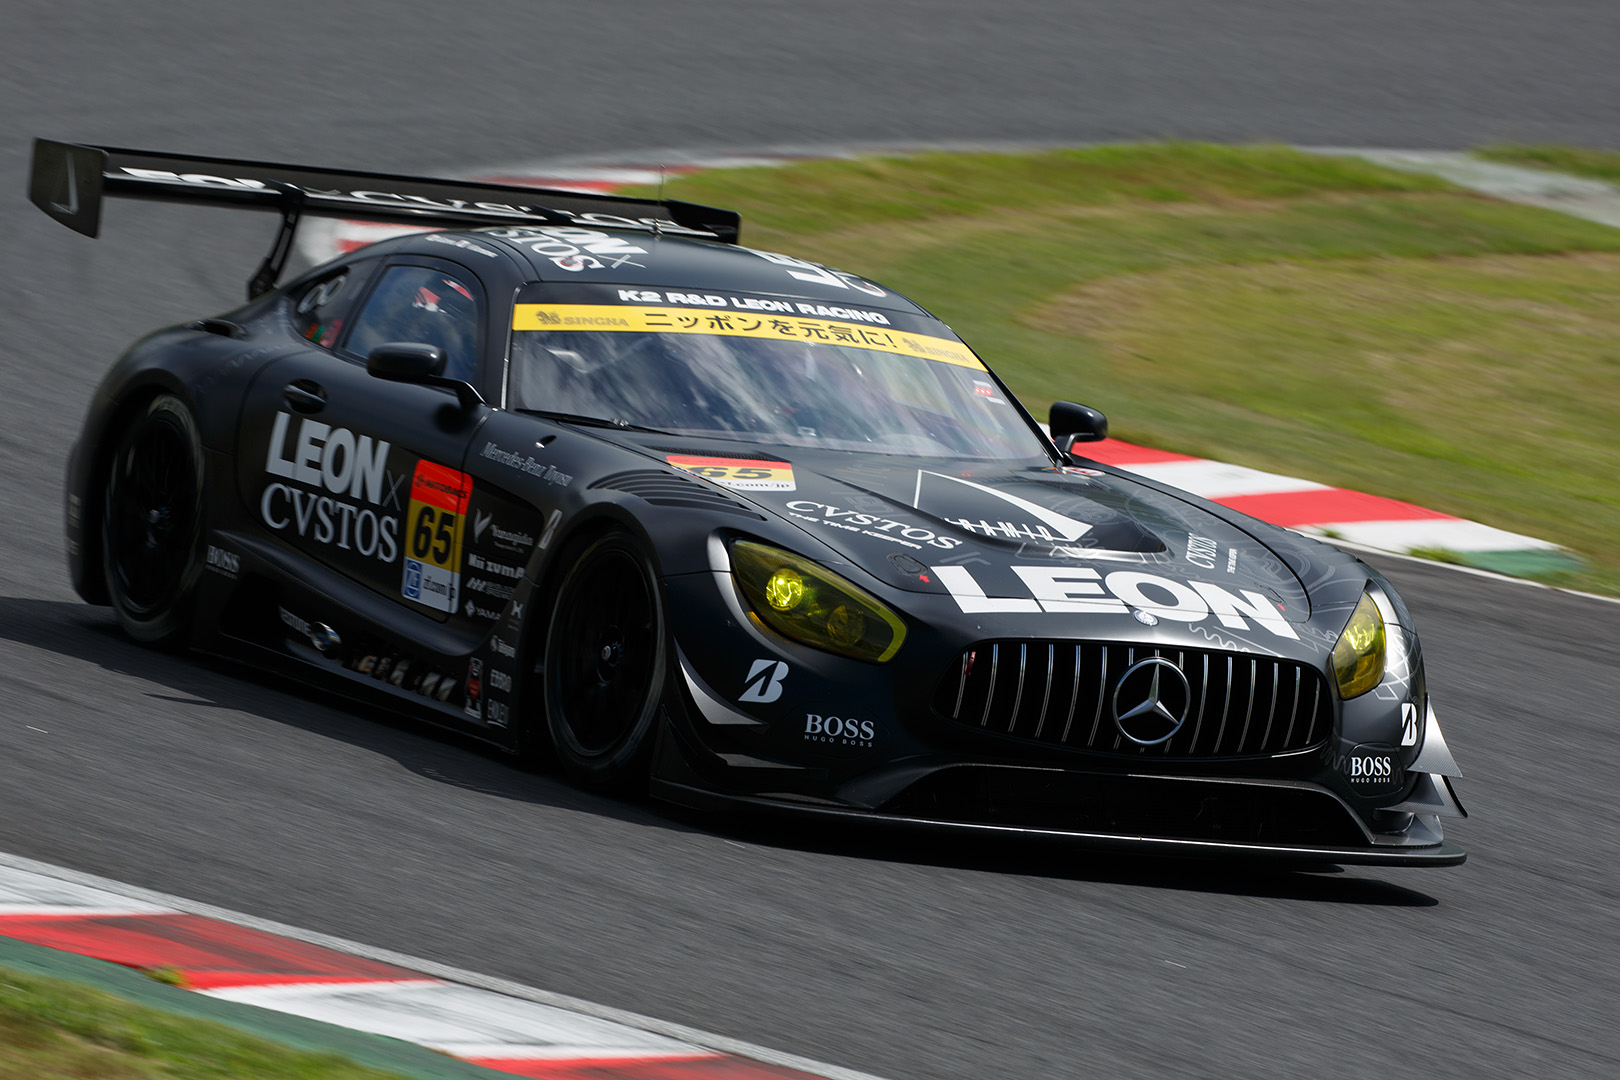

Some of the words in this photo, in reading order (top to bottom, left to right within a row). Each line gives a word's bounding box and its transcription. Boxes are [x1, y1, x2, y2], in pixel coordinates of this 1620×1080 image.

[618, 289, 662, 305] K2
[666, 292, 728, 308] R&D
[731, 297, 796, 313] LEON
[795, 302, 891, 325] RACING
[265, 411, 391, 506] LEON
[688, 466, 773, 480] 65
[260, 483, 399, 564] CVSTOS
[414, 506, 455, 564] 65
[786, 500, 964, 549] CVSTOS
[788, 511, 820, 523] THE
[823, 518, 860, 532] TIME
[930, 565, 1301, 640] LEON
[804, 713, 877, 740] BOSS
[804, 734, 835, 743] HUGO
[842, 738, 873, 748] BOSS
[1350, 756, 1392, 777] BOSS
